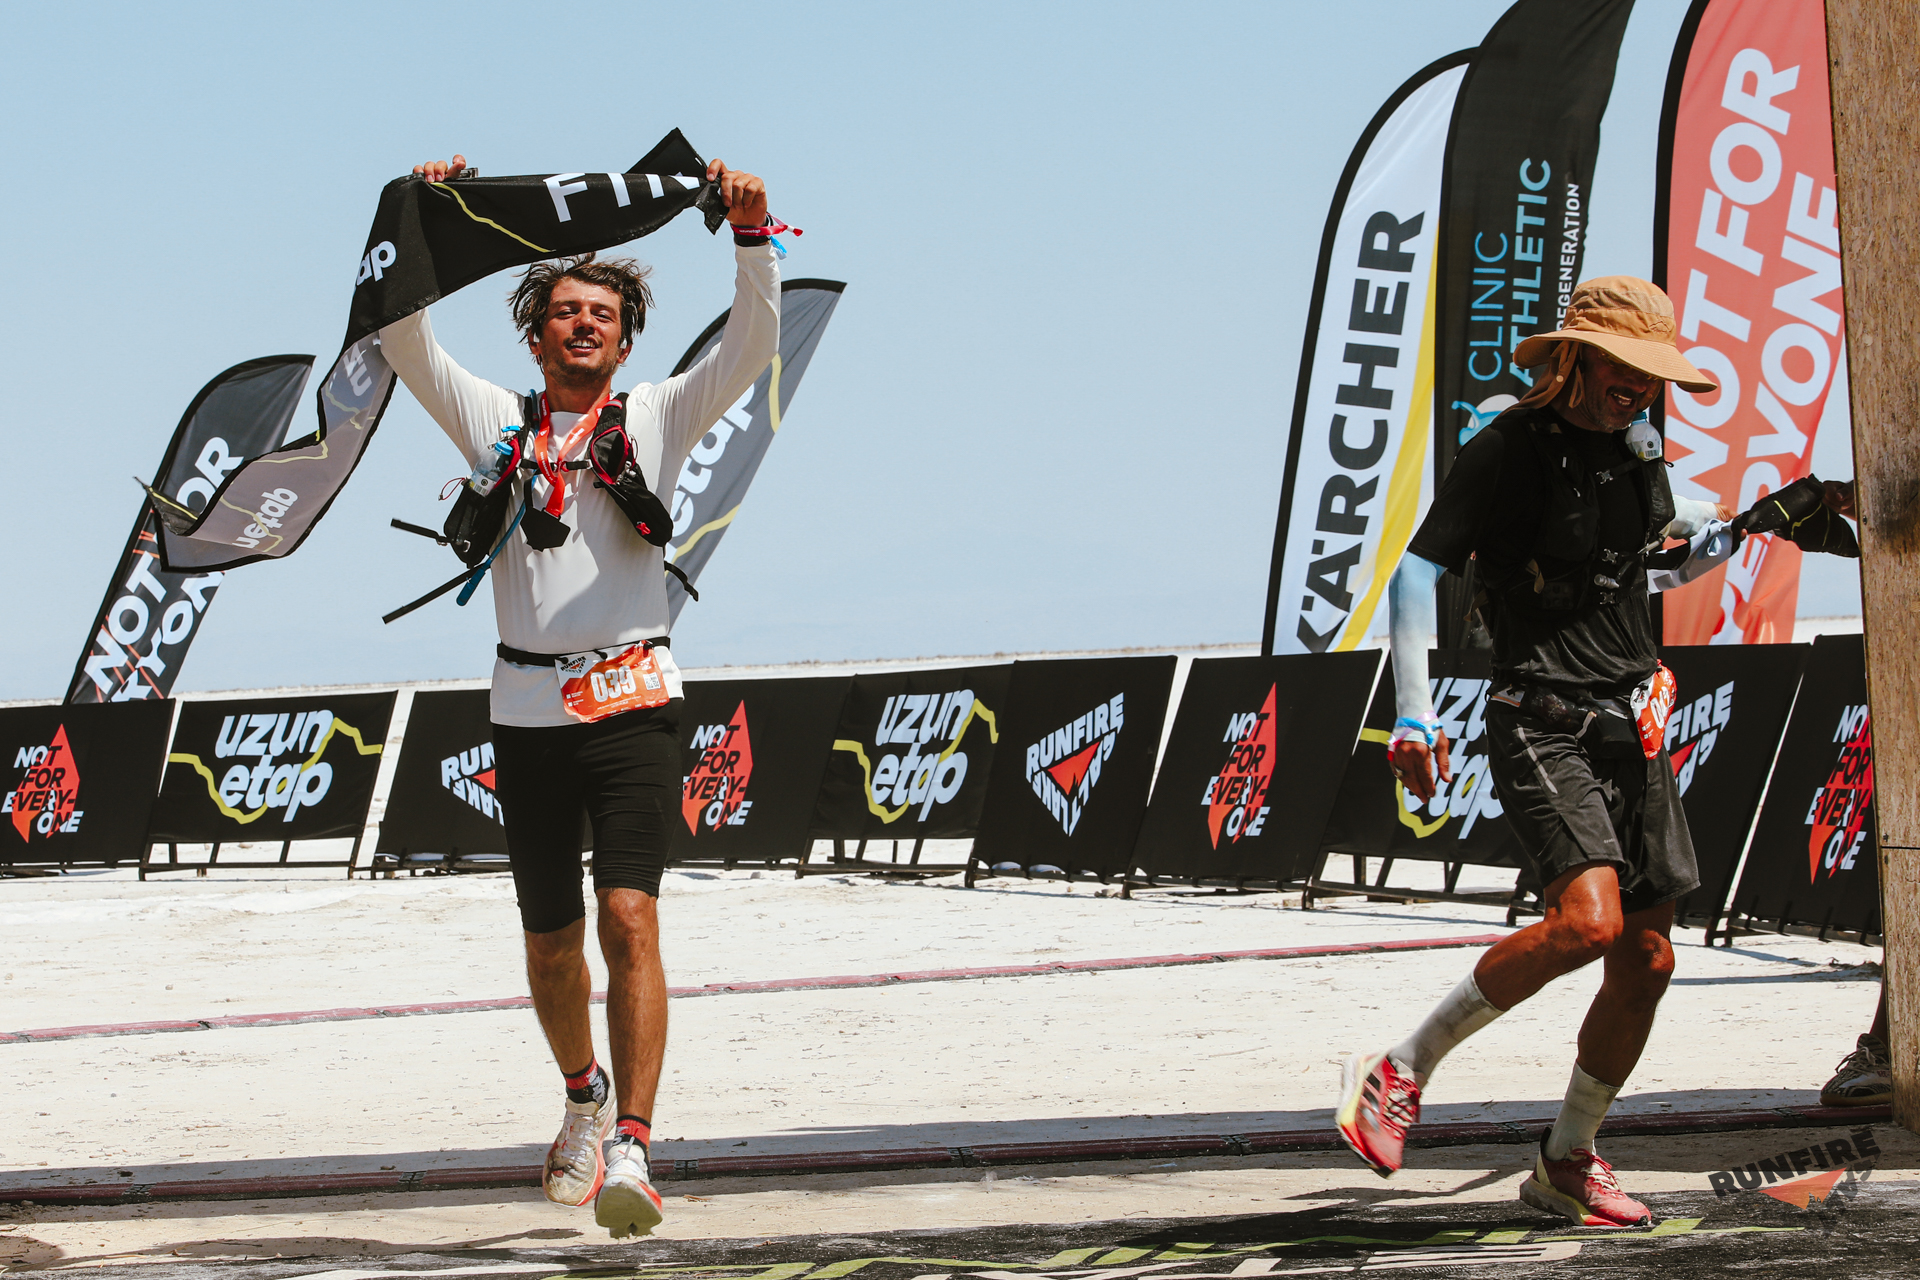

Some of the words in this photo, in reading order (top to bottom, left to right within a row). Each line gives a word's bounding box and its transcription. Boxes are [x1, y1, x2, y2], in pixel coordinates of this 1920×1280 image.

[1695, 48, 1800, 276] FOR
[1509, 158, 1551, 387] ATHLETIC
[1468, 232, 1508, 381] CLINIC
[1296, 211, 1425, 652] KÄRCHER
[84, 551, 167, 694] NOT
[176, 437, 244, 514] OR
[590, 665, 637, 703] 039
[215, 709, 334, 758] uzun
[689, 724, 741, 749] NOT
[875, 689, 975, 746] uzun
[1026, 692, 1124, 783] RUNFIRE
[1222, 712, 1270, 743] NOT
[13, 745, 63, 768] NOT
[695, 750, 741, 775] FOR
[1224, 743, 1267, 774] FOR
[20, 767, 66, 790] FOR
[218, 754, 334, 822] etap
[871, 742, 969, 822] etap
[37, 811, 84, 834] ONE
[705, 800, 753, 826] ONE
[1226, 806, 1270, 837] ONE
[1825, 830, 1867, 870] ONE
